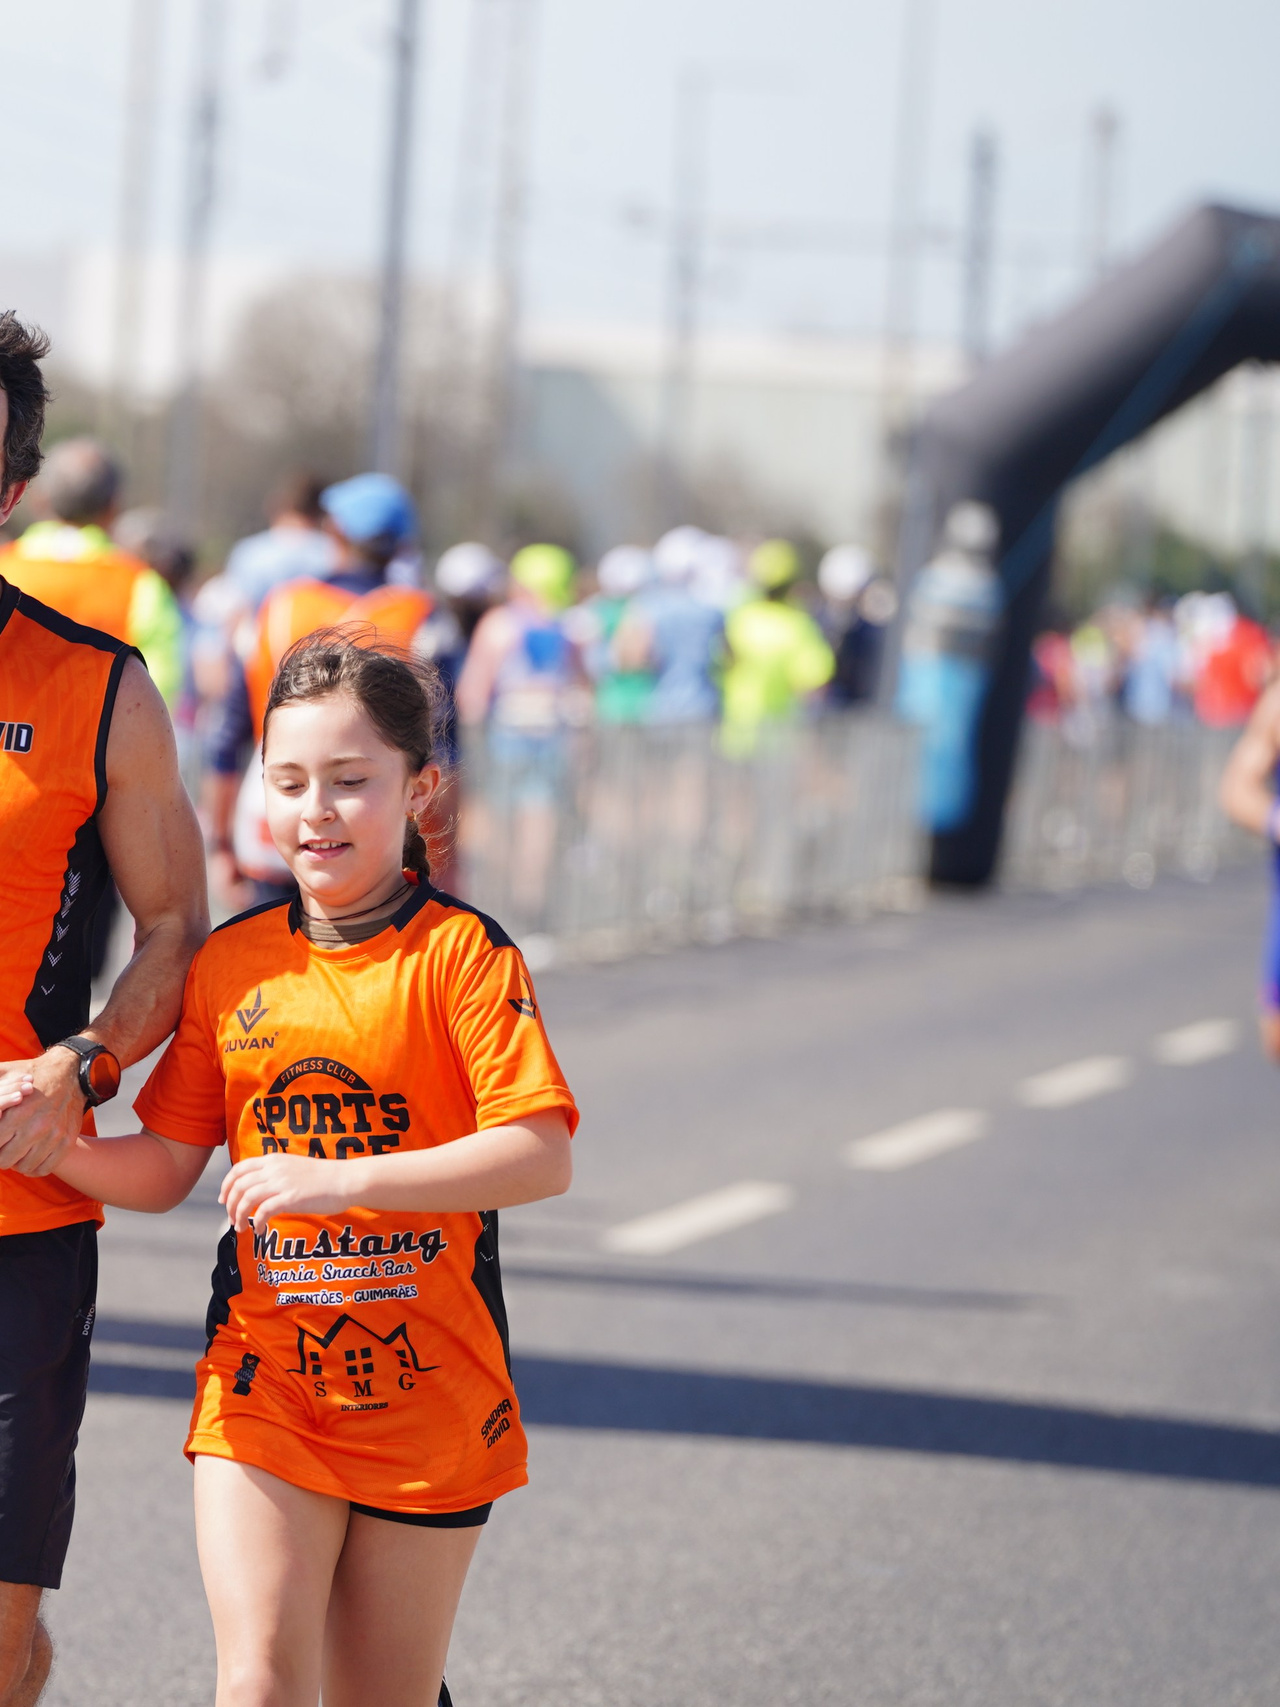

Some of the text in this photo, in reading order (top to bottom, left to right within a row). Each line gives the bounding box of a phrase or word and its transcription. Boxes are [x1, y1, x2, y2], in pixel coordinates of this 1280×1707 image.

[225, 1037, 275, 1053] JUVAN
[280, 1060, 358, 1085] FITNESS CLUB
[253, 1093, 411, 1136] SPORTS
[248, 1216, 448, 1265] Mustang
[257, 1263, 318, 1288] Pizzaria
[382, 1257, 418, 1278] Bar
[276, 1289, 345, 1307] FERMENTÕES
[353, 1285, 419, 1303] GUIMARÃES
[314, 1372, 417, 1398] S M G
[480, 1398, 513, 1441] SANDRA
[487, 1417, 511, 1449] DAVID
